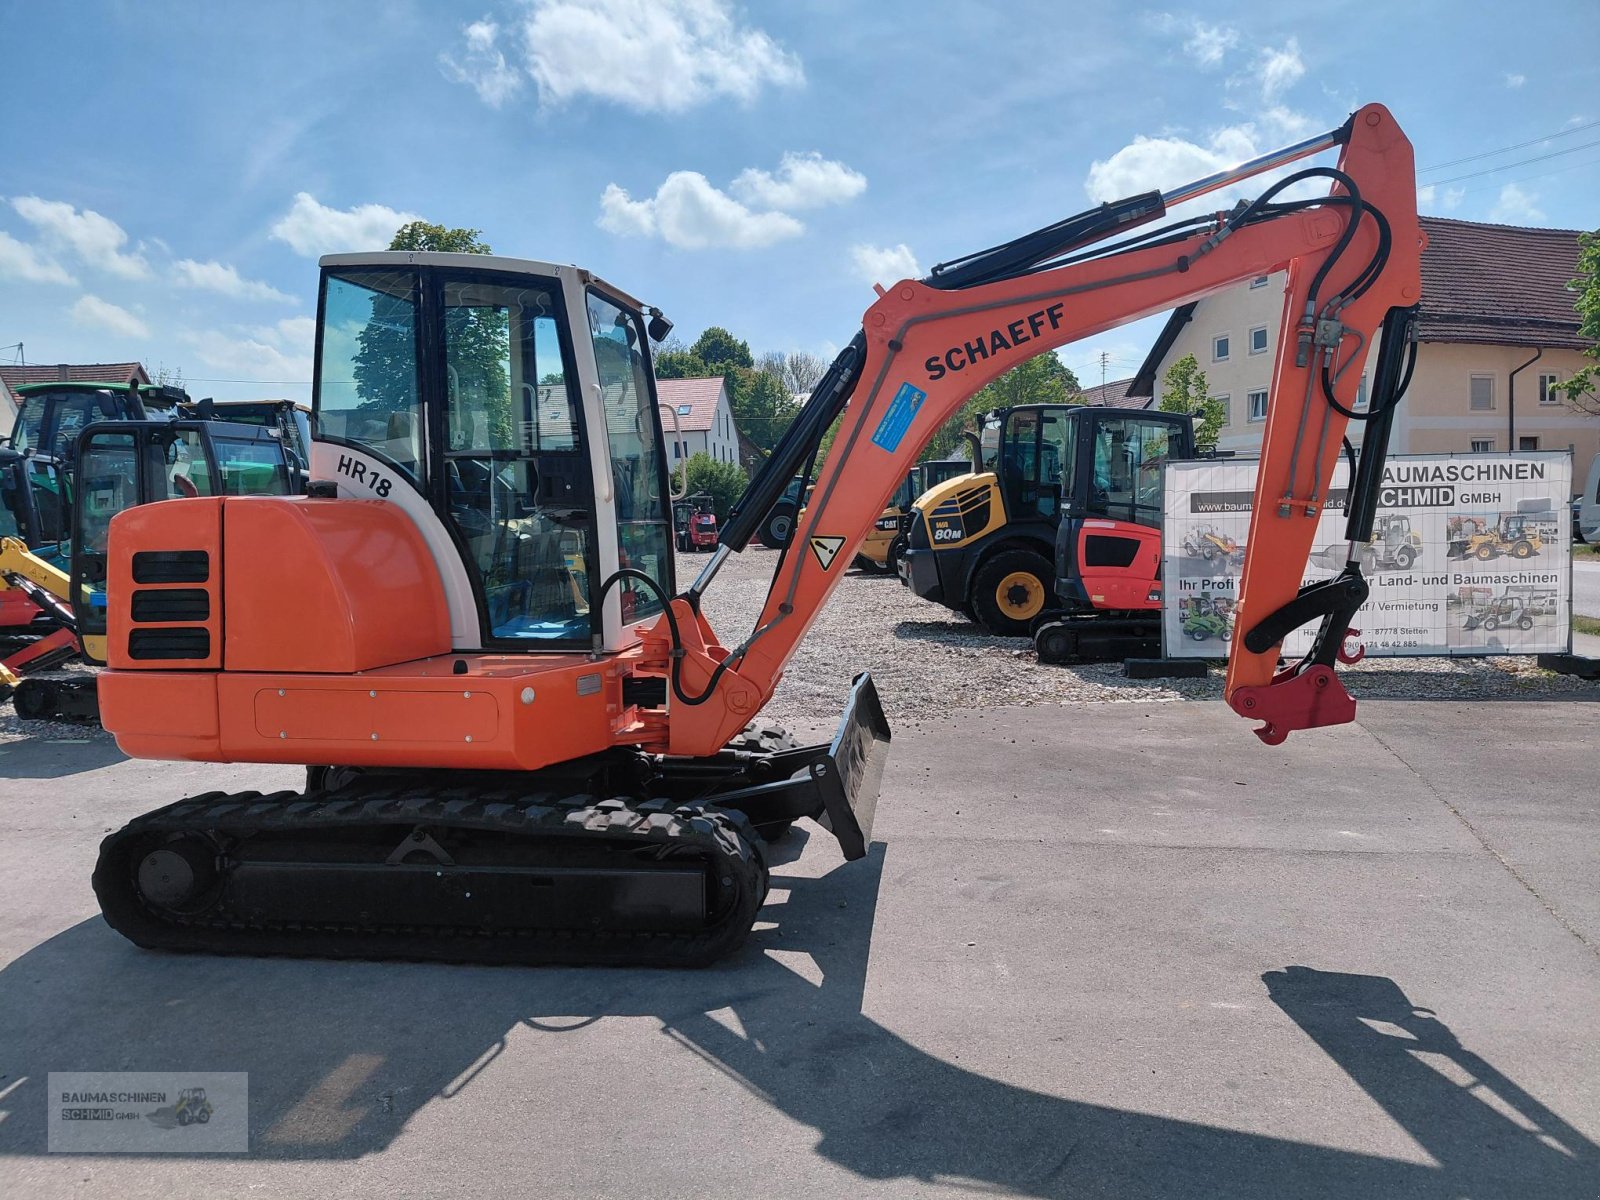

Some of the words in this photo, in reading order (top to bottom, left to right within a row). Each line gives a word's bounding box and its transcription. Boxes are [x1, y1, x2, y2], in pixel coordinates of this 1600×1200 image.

[925, 302, 1064, 380] SCHAEFF
[337, 454, 392, 497] HR18
[1382, 463, 1545, 483] AUMASCHINEN
[1377, 487, 1454, 506] CHMID
[1460, 492, 1501, 504] GMBH
[884, 520, 896, 529] CAT
[1179, 579, 1196, 590] Ihr
[1202, 578, 1234, 590] Profi
[1379, 575, 1418, 586] Land-
[1422, 574, 1448, 586] und
[1453, 573, 1558, 585] Baumaschinen
[1378, 602, 1439, 612] Vermietung
[1400, 627, 1429, 635] Stetten
